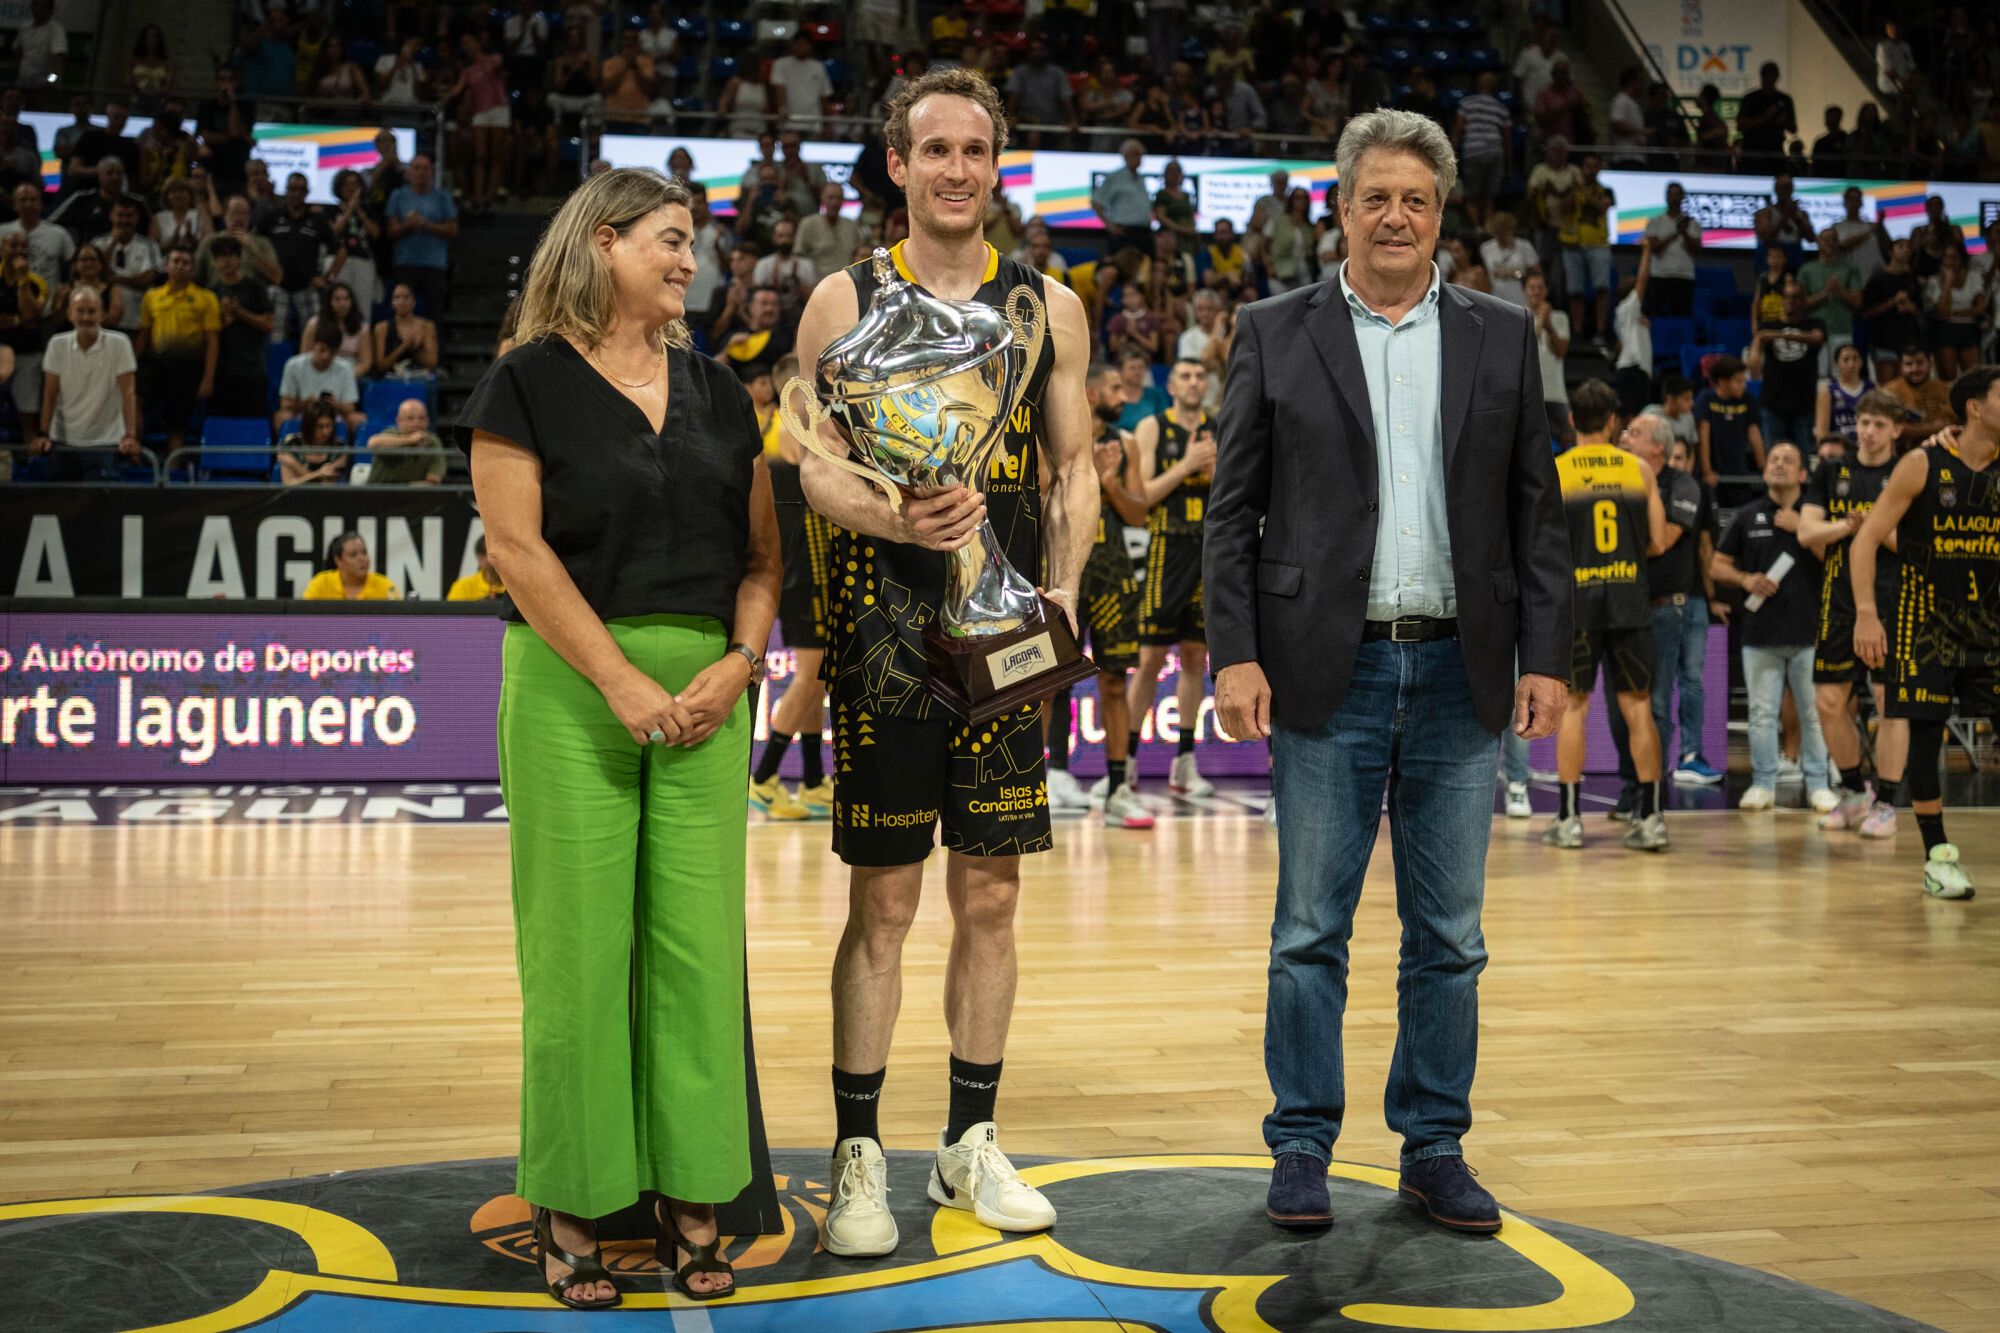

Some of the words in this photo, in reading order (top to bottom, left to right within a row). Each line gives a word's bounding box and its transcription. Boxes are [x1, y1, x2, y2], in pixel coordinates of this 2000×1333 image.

[1677, 44, 1752, 72] DXT
[1594, 499, 1618, 554] 6
[1933, 514, 1955, 531] LA
[14, 514, 76, 599] A
[21, 640, 205, 672] Autónomo
[214, 640, 256, 672] de
[265, 642, 415, 680] Deportes
[0, 684, 97, 747] rte
[118, 675, 416, 766] lagunero
[1000, 785, 1033, 800] Islas
[968, 797, 1034, 814] Canarias
[874, 808, 938, 829] Hospiten
[850, 1143, 863, 1159] S
